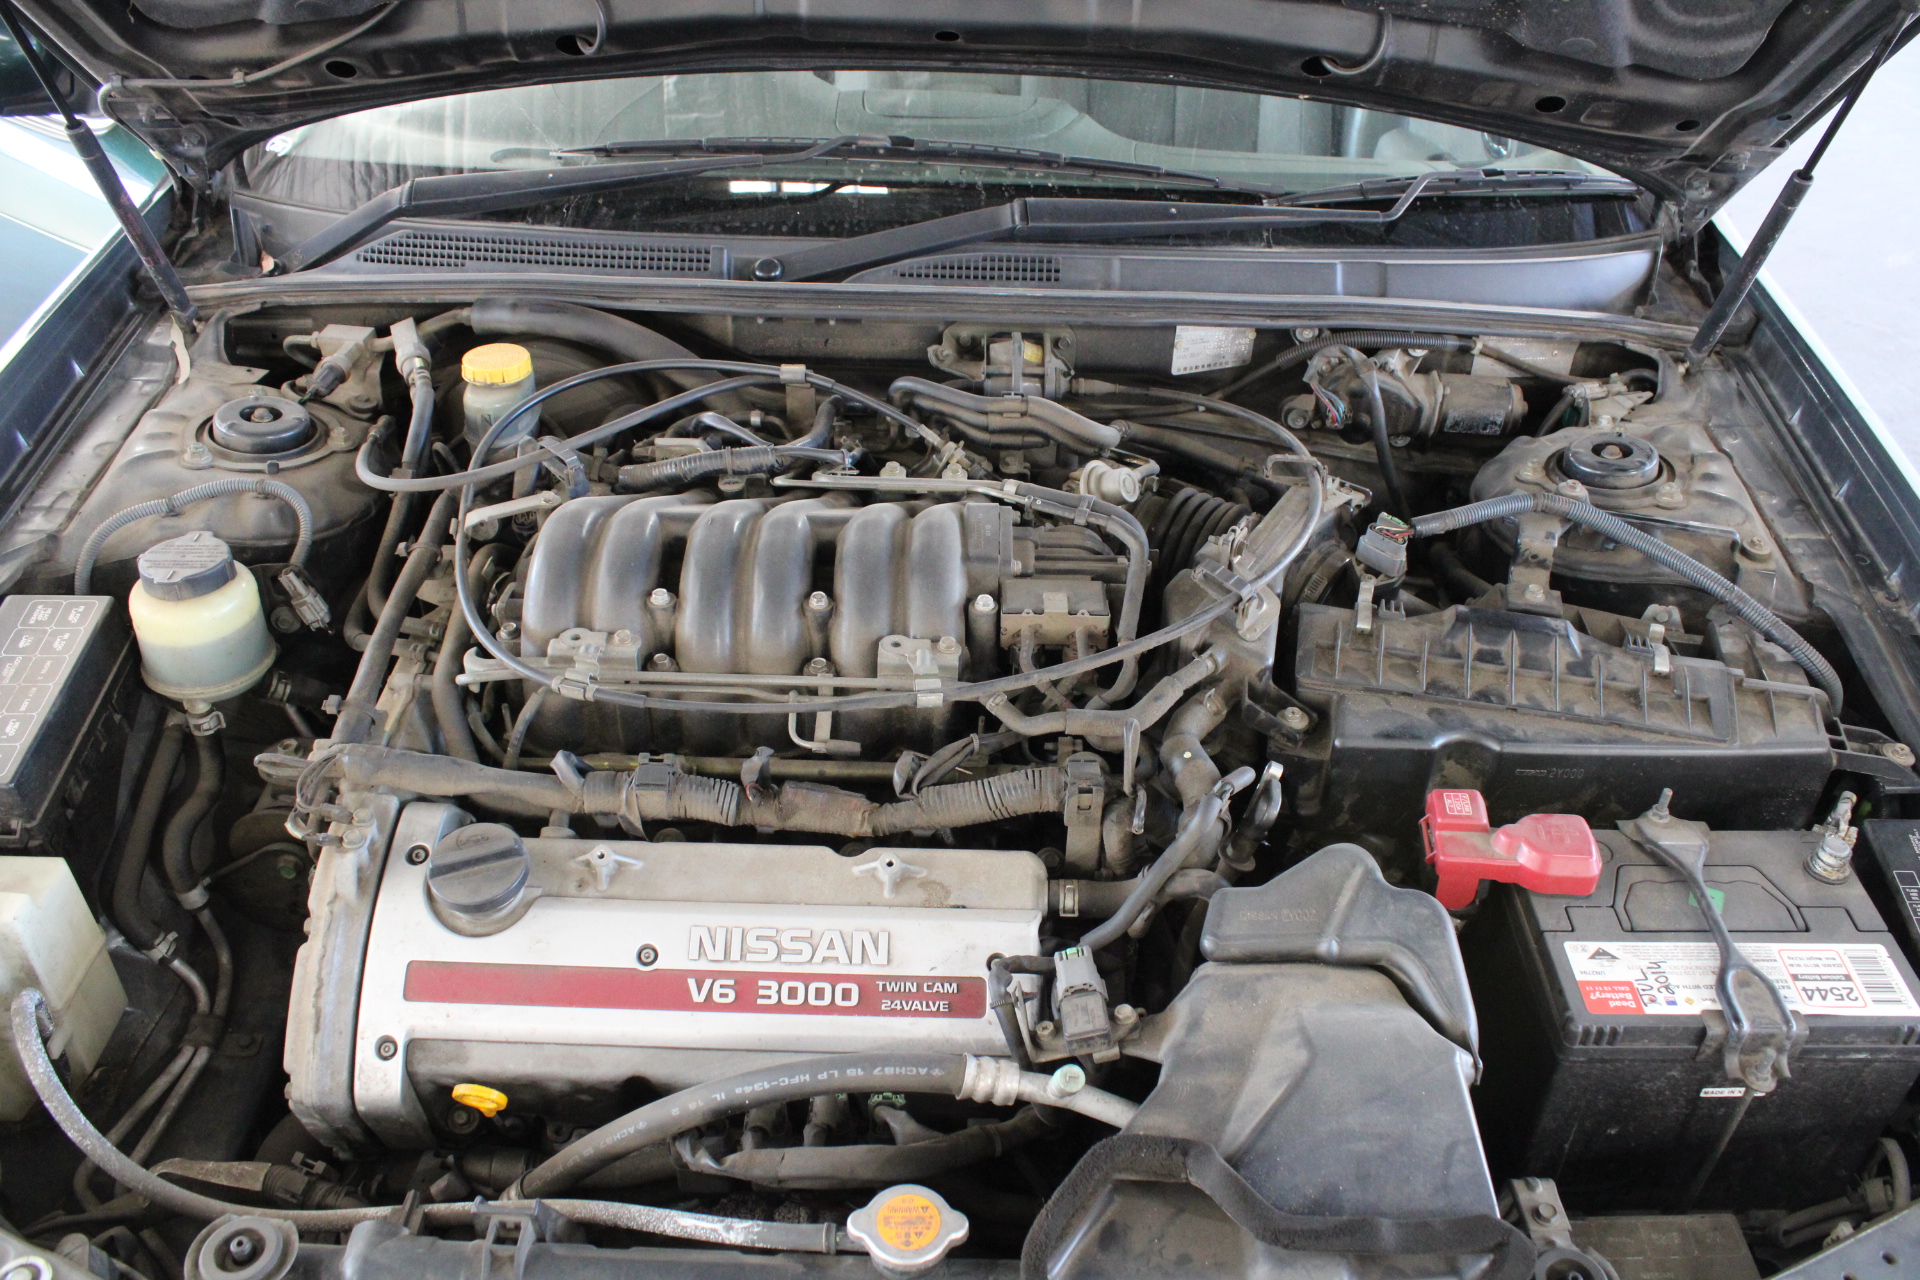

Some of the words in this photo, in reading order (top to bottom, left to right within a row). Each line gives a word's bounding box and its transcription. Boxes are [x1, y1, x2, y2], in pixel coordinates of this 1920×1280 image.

[688, 924, 890, 965] NISSAN
[687, 977, 736, 1003] V6
[757, 980, 859, 1007] 3000
[876, 981, 917, 993] TWIN
[923, 982, 957, 994] CAM
[1801, 986, 1859, 1002] 2544
[1589, 991, 1633, 1000] Battery?
[882, 999, 949, 1012] 24VALVE
[1608, 1000, 1637, 1008] Dead
[817, 1070, 839, 1081] LP
[734, 1072, 810, 1095] HFC-134a
